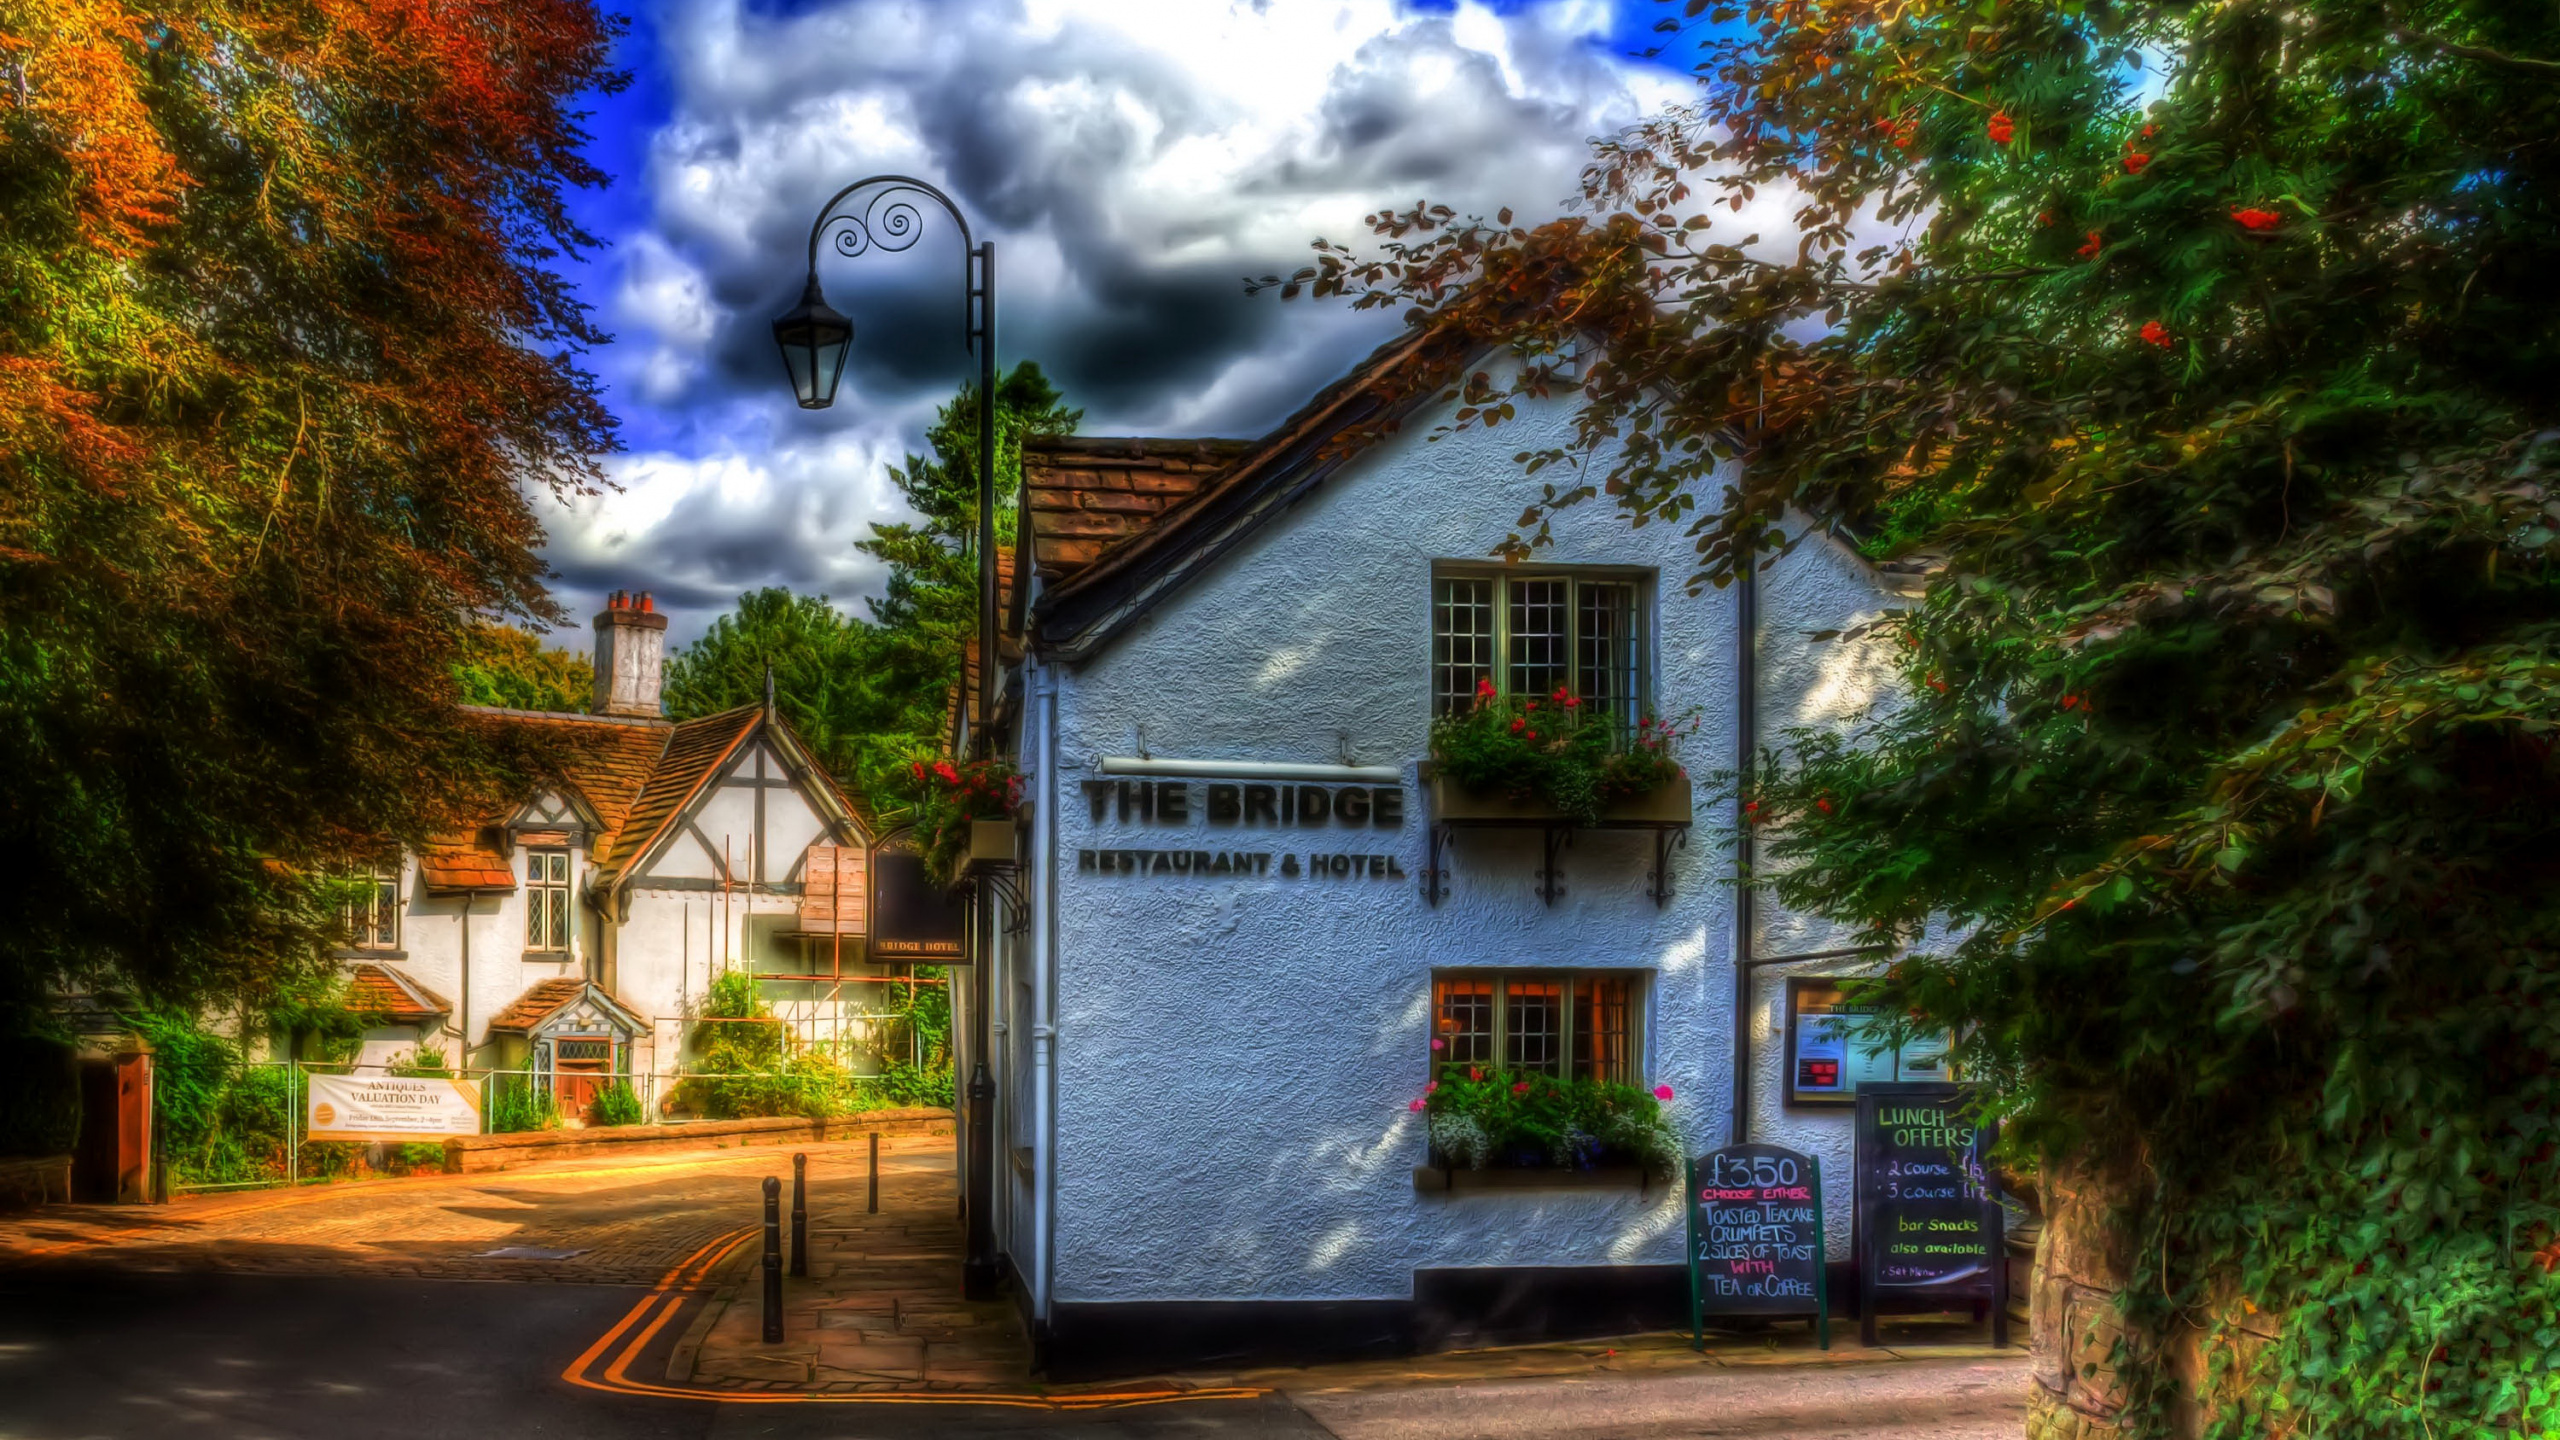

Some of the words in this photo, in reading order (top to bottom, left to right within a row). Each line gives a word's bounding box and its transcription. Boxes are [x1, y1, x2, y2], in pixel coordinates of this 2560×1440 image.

[1080, 780, 1188, 823] THE
[1207, 783, 1404, 826] BRIDGE
[1079, 850, 1271, 875] RESTAURANT
[1281, 853, 1300, 874] &
[1311, 853, 1405, 878] HOTEL
[879, 941, 920, 951] BRIDGE
[925, 942, 960, 952] HOTEL
[367, 1081, 426, 1093] ANTIQUES
[350, 1092, 417, 1104] VALUATION
[419, 1094, 442, 1105] DAY
[1879, 1108, 1945, 1128] LUNCH
[1894, 1128, 1974, 1147] OFFERS
[1707, 1153, 1799, 1189] £3.50
[1888, 1160, 1902, 1176] 2
[1702, 1188, 1755, 1200] CHOOSE
[1763, 1187, 1810, 1199] EITHER
[1887, 1182, 1899, 1199] 3
[1700, 1201, 1760, 1225] TOASTED
[1757, 1201, 1815, 1223] TEACAKE
[1899, 1215, 1924, 1232] bar
[1711, 1224, 1797, 1243] CRUMPETS
[1699, 1241, 1710, 1260] 2
[1711, 1243, 1750, 1260] SLICES
[1752, 1243, 1770, 1259] OF
[1771, 1243, 1816, 1262] TOAST
[1890, 1243, 1918, 1254] also
[1924, 1243, 1988, 1255] available
[1731, 1260, 1775, 1274] WITH
[1707, 1274, 1743, 1296] TEA
[1764, 1274, 1815, 1297] COFFEE
